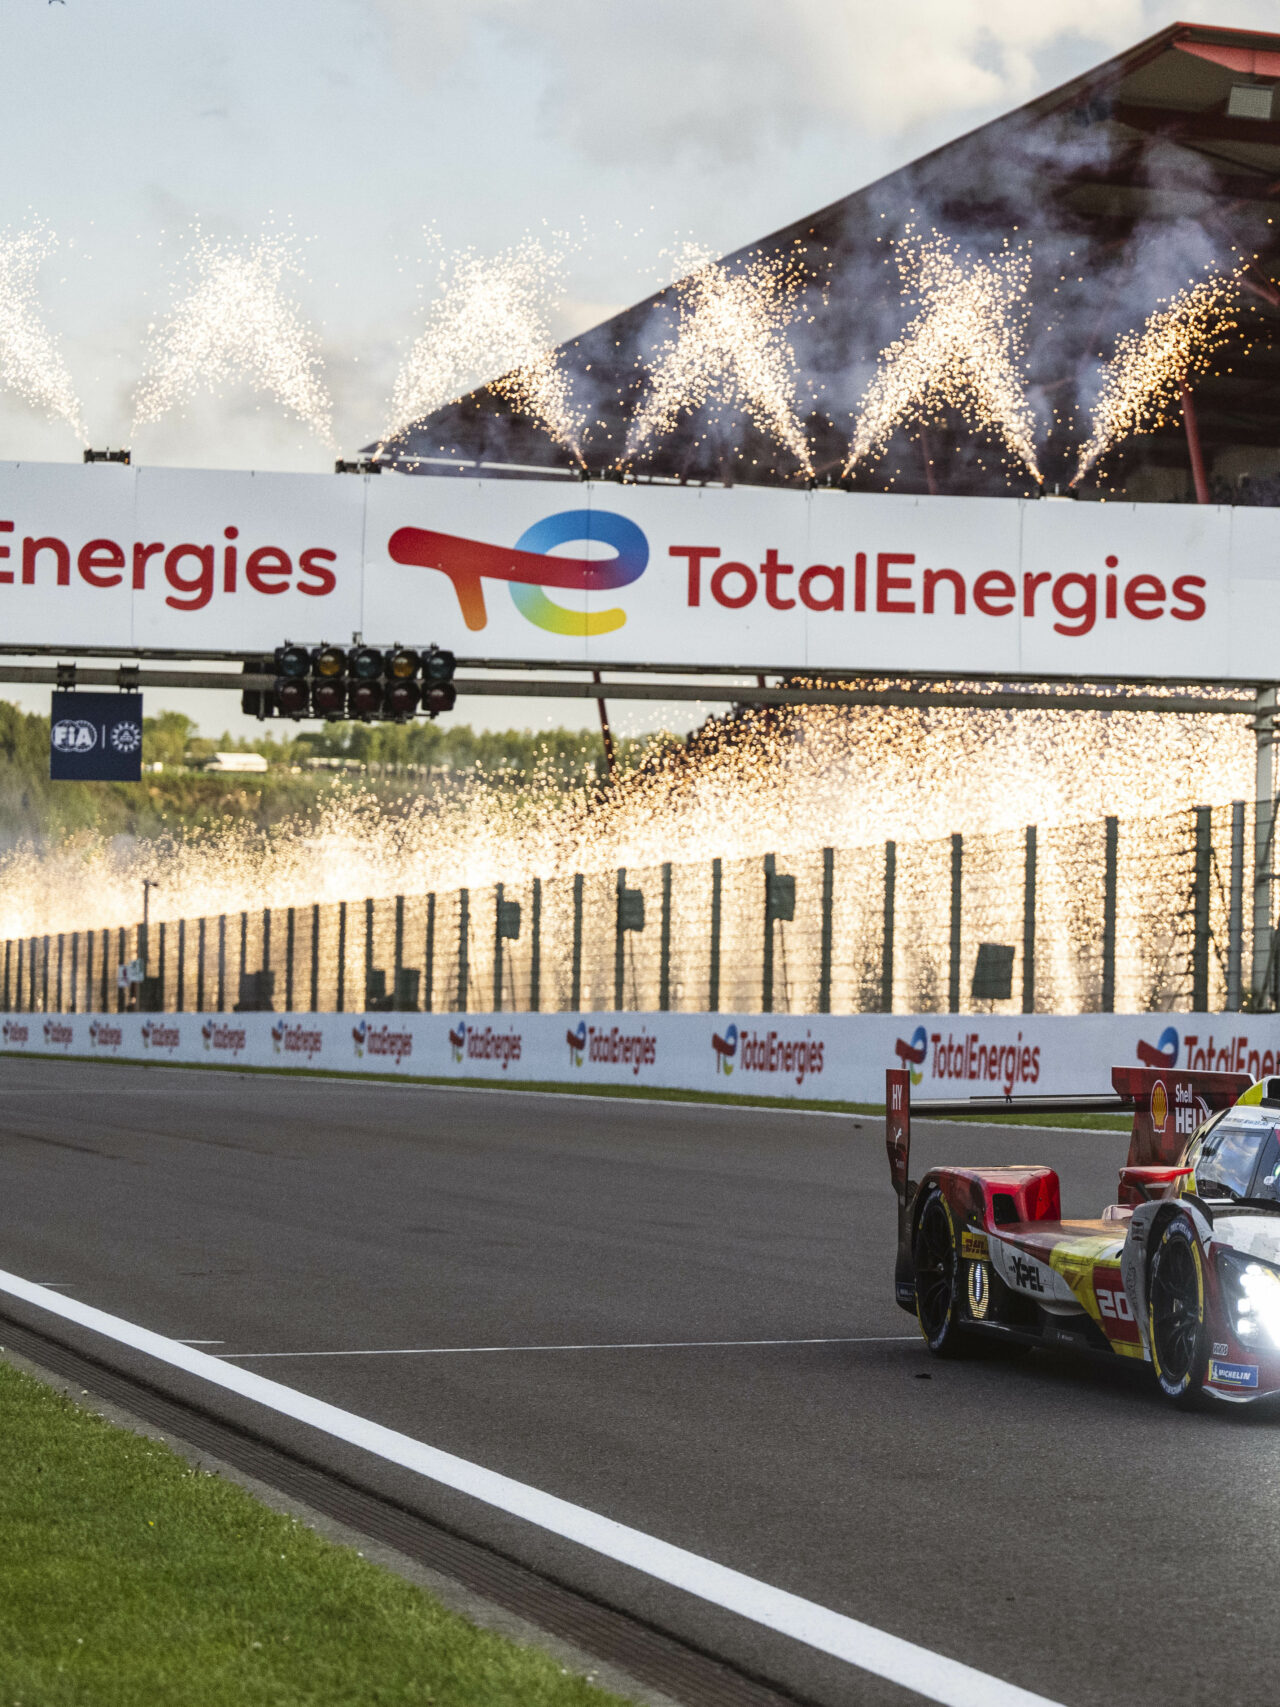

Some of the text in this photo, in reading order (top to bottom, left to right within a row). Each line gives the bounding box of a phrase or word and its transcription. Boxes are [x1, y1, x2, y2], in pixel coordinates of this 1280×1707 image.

[669, 546, 1208, 638] TotalEnergies
[466, 1025, 522, 1070] TotalEnergies
[588, 1025, 657, 1075] TotalEnergies
[740, 1029, 825, 1085] TotalEnergies
[931, 1031, 1041, 1095] TotalEnergies
[892, 1084, 903, 1110] HY
[1175, 1083, 1193, 1103] Shell
[1011, 1256, 1044, 1293] XPEL
[1096, 1289, 1135, 1322] 20
[1218, 1369, 1251, 1380] MICHELIN
